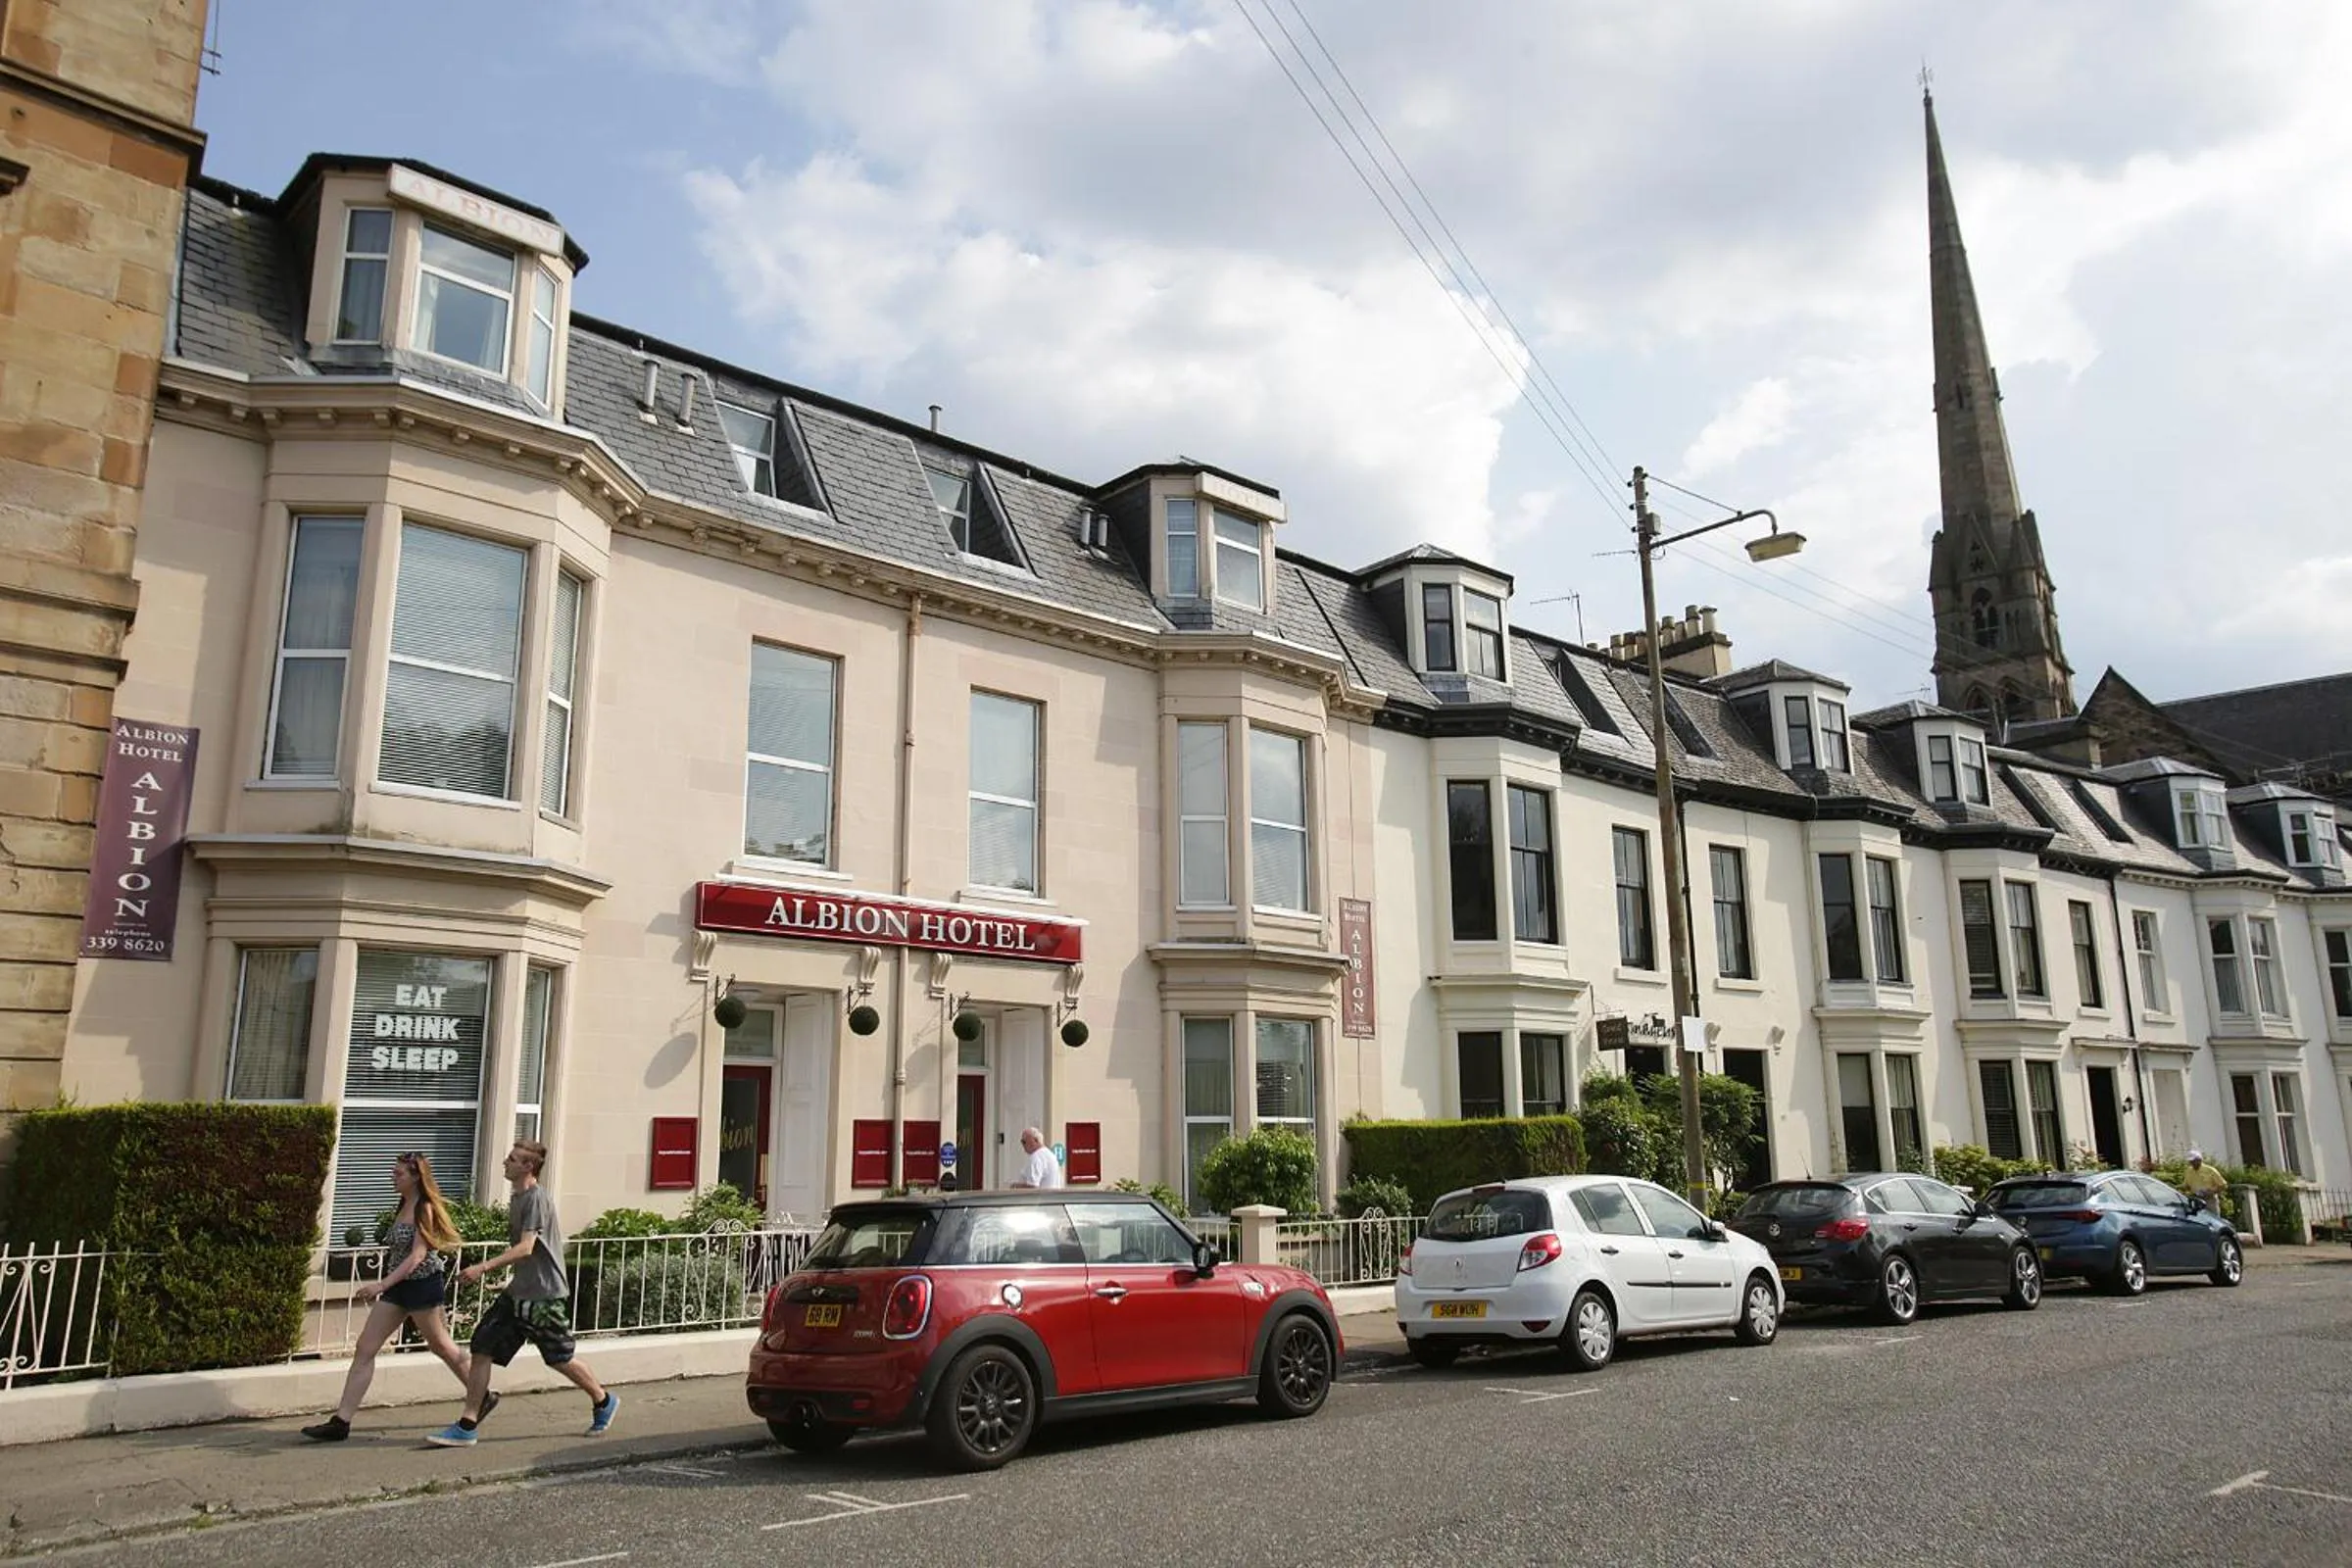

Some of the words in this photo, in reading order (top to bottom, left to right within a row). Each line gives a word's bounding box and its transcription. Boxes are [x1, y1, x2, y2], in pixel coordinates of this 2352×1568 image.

[408, 178, 556, 241] ALBION
[116, 724, 189, 745] ALBION
[118, 742, 183, 762] HOTEL
[114, 771, 163, 918] ALBION
[764, 896, 910, 939] ALBION
[919, 912, 1036, 952] HOTEL
[86, 936, 118, 950] 339
[123, 938, 166, 953] 8620
[1351, 928, 1364, 1015] ALBION
[395, 984, 448, 1007] EAT
[374, 1013, 461, 1041] DRINK
[371, 1046, 460, 1072] SLEEP
